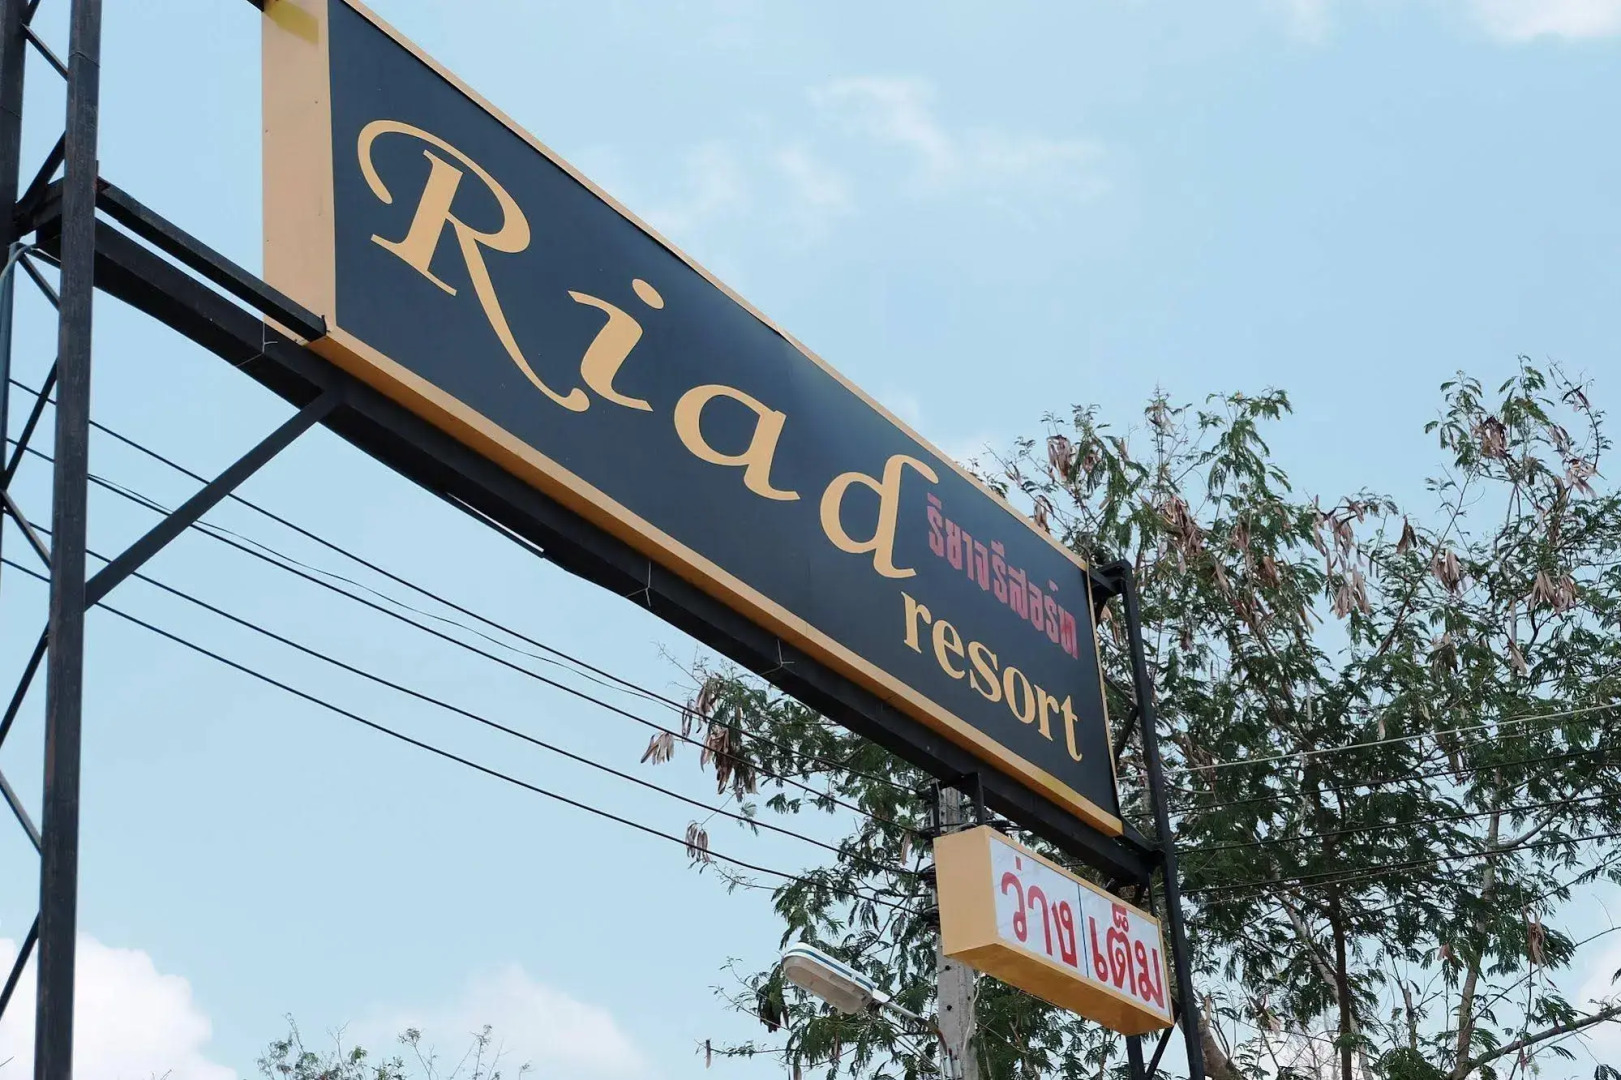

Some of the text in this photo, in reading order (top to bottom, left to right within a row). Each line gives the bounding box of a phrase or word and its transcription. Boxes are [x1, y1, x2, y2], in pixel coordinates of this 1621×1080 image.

[357, 119, 940, 579] Riad
[901, 591, 1082, 762] resort
[1001, 856, 1165, 1009] ว่าง เต็ม
